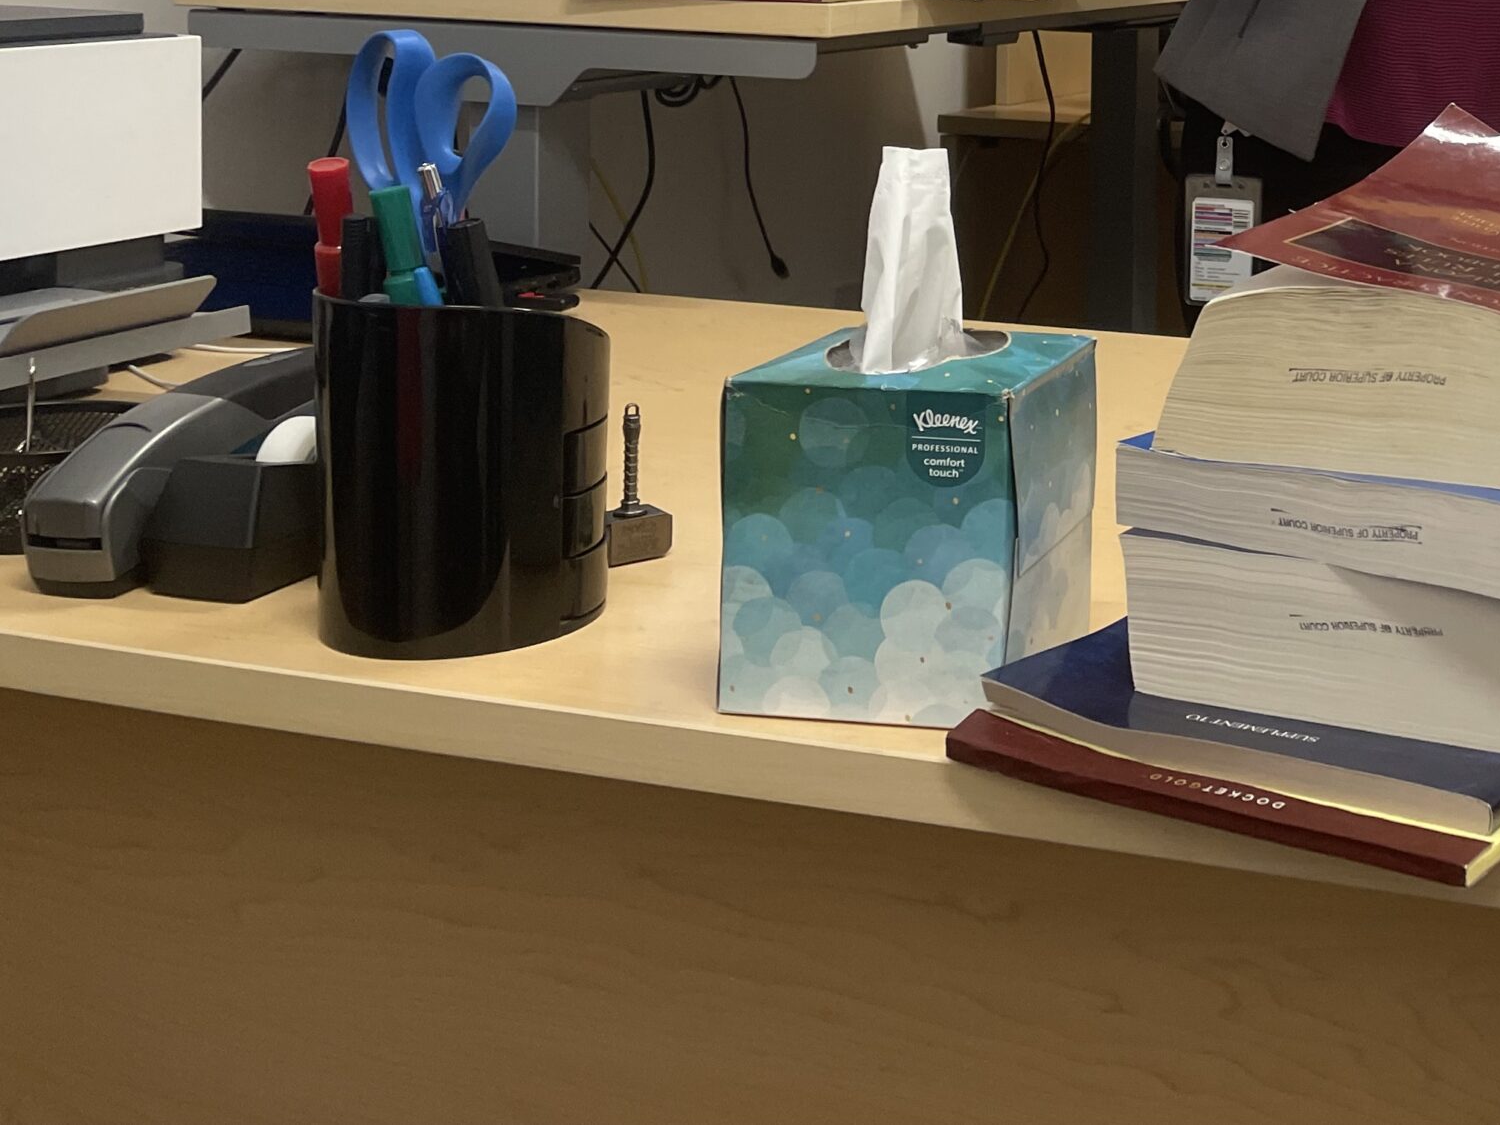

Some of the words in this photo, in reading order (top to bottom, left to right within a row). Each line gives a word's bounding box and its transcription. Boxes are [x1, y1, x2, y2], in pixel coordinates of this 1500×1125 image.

[1292, 371, 1326, 383] COURT
[1328, 371, 1377, 383] SUPERIOR
[912, 409, 979, 434] Kleenex
[911, 443, 979, 454] PROFESSIONAL
[923, 457, 966, 467] comfort
[929, 468, 960, 478] touch
[1278, 517, 1308, 530] COURT
[1310, 521, 1354, 538] SUPERIOR
[1356, 528, 1369, 539] OF
[1372, 528, 1418, 541] PROPERTY
[1299, 622, 1329, 631] COURT
[1331, 621, 1377, 632] SUPERIOR
[1185, 713, 1209, 724] TO
[1208, 718, 1321, 744] SUPPLEMENT
